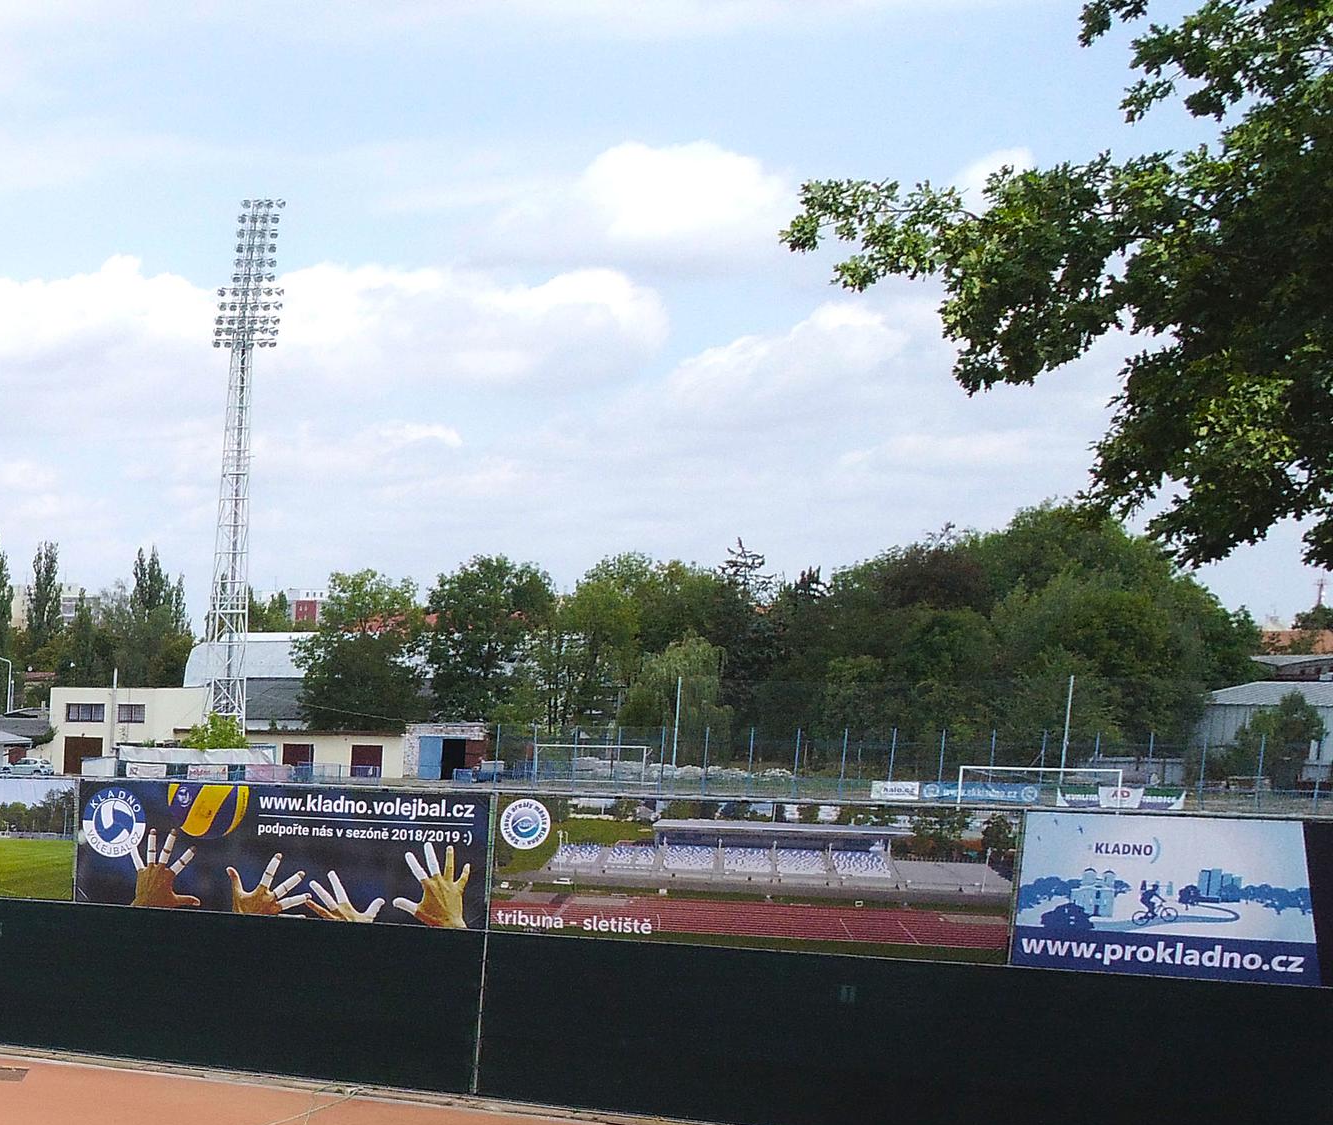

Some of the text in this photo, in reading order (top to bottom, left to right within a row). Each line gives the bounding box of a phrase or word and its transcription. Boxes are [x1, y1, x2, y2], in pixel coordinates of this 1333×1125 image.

[90, 790, 141, 812] KLADNO
[259, 794, 475, 821] www.kladno.volejbal.cz
[258, 823, 309, 837] podpořte
[312, 825, 333, 838] nás
[336, 829, 343, 838] v
[346, 827, 389, 840] sezóně
[391, 828, 460, 843] 2018/2019
[1095, 842, 1153, 857] KLADNO
[496, 910, 564, 929] tribuna
[583, 915, 652, 934] sletiště
[1021, 936, 1306, 974] www.prokladno.cz
